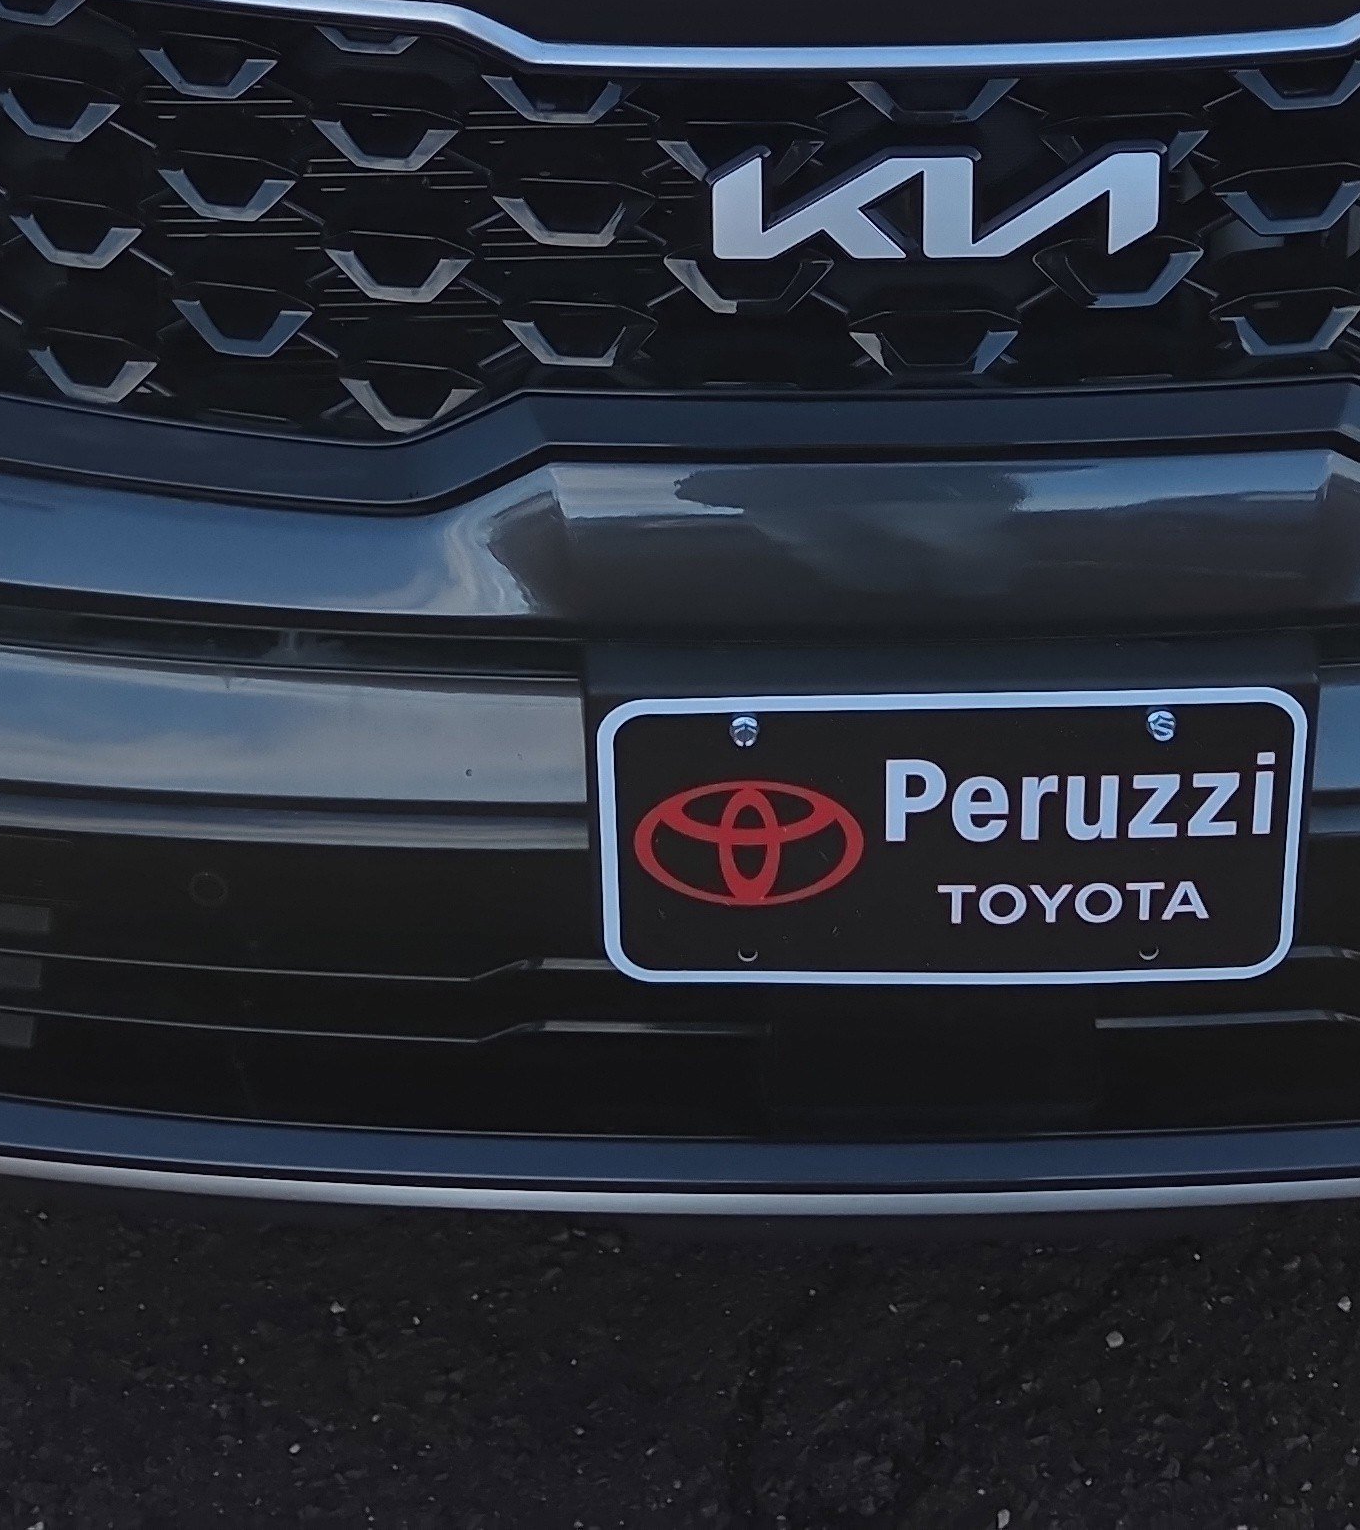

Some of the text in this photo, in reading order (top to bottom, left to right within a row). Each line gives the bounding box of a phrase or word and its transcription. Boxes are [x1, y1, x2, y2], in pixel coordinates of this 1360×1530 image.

[711, 151, 1161, 260] KIA
[883, 750, 1276, 843] Peruzzi
[937, 880, 1210, 925] TOYOTA
